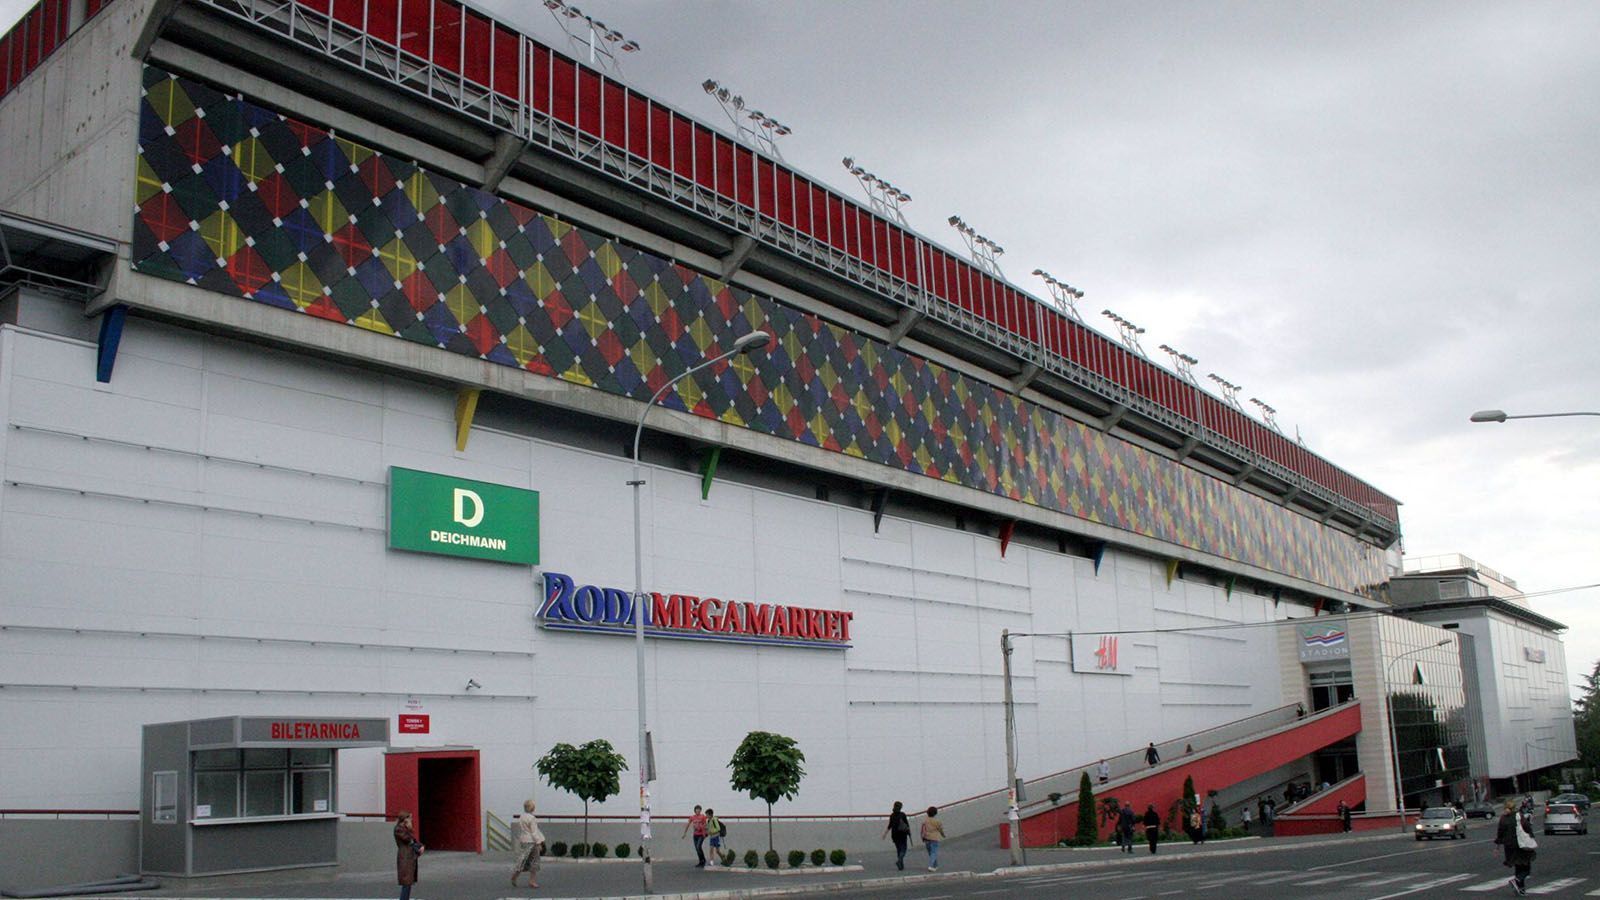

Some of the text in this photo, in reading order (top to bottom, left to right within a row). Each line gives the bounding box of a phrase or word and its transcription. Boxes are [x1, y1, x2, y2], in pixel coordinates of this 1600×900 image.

[453, 488, 485, 528] D
[430, 530, 507, 551] DEICHMANN
[650, 592, 854, 641] MEGAMARKET
[1300, 647, 1349, 658] STADION
[271, 722, 361, 740] BILETARNICA
